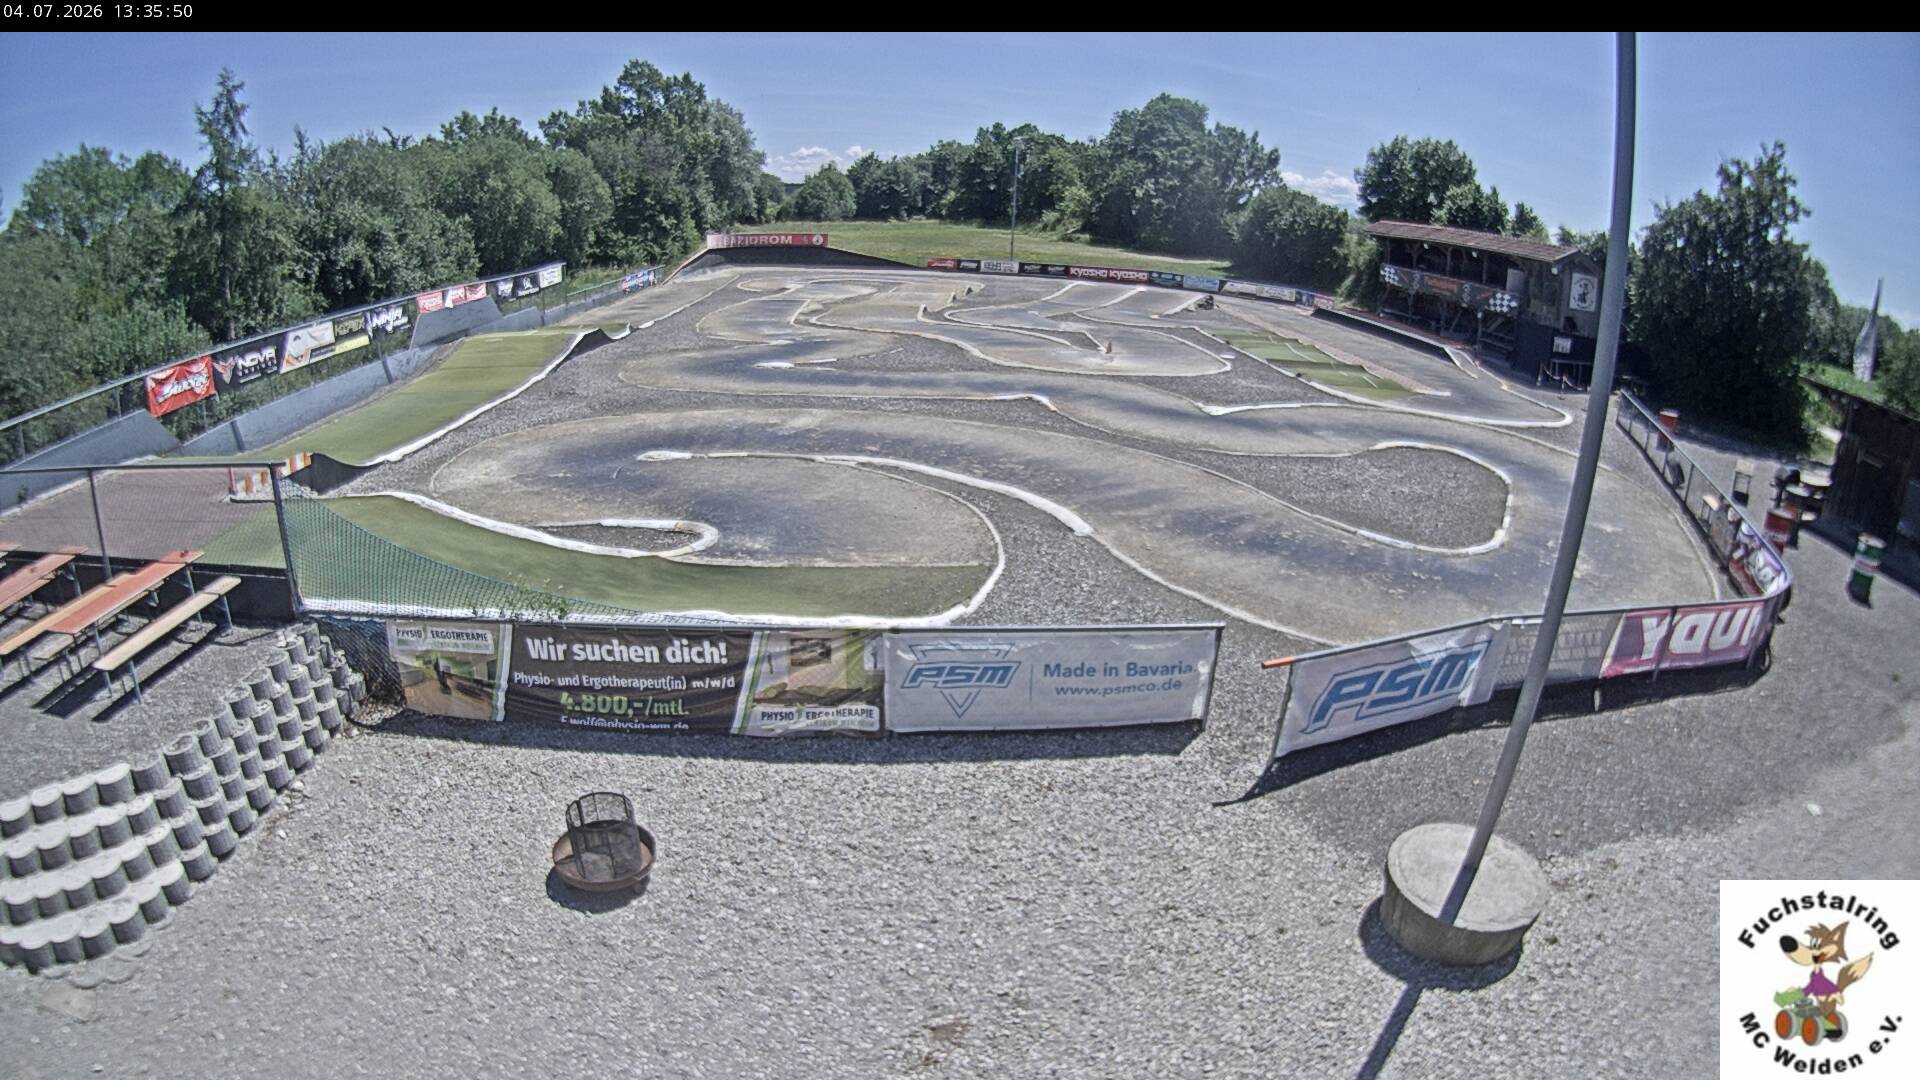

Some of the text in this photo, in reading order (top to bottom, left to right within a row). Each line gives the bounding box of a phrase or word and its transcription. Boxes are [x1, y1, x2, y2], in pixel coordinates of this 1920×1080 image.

[430, 630, 488, 642] ERGOTHERAPIE
[526, 637, 728, 665] Wir suchen dich!
[904, 663, 1018, 687] PSM
[1043, 662, 1096, 678] Made
[1104, 662, 1118, 677] in
[514, 671, 735, 692] Physio- und Ergotherapeut(in) m/w/d
[1055, 678, 1182, 697] www.psmco.de
[1308, 647, 1484, 726] PSM
[761, 711, 794, 721] PHYSIO
